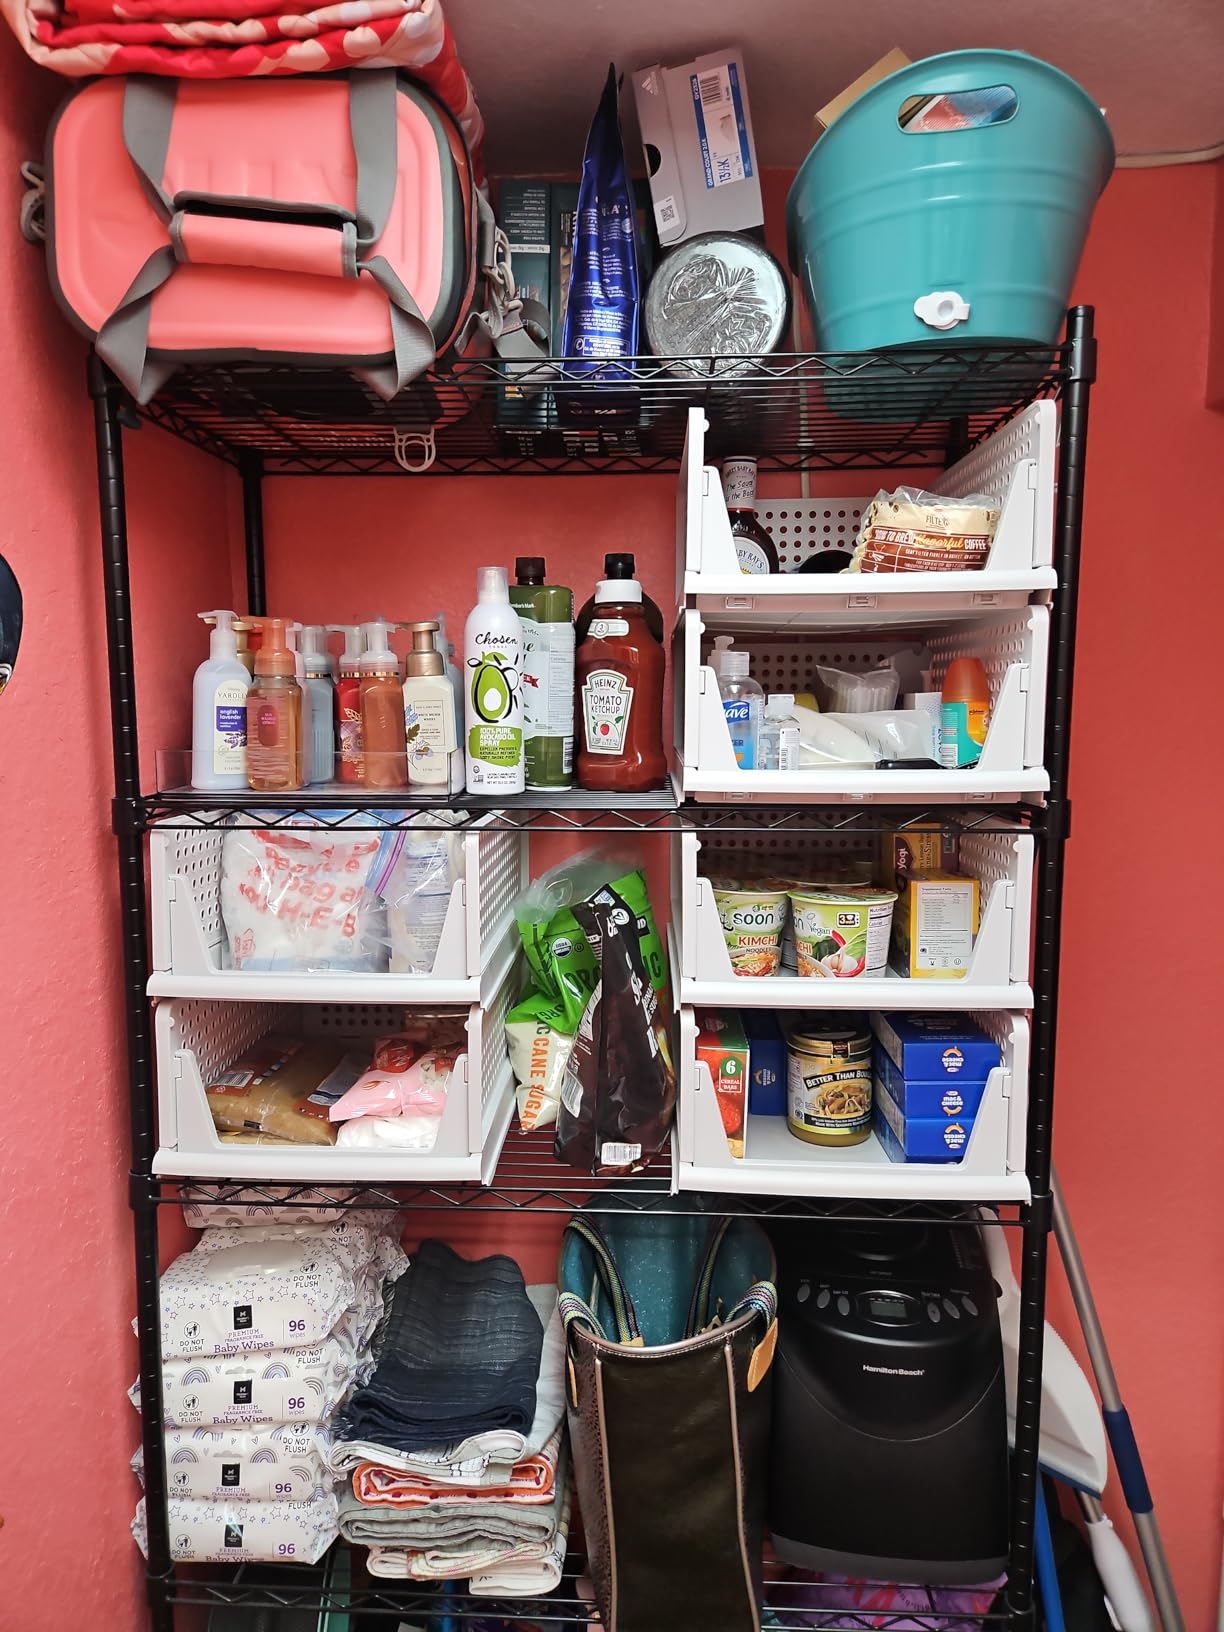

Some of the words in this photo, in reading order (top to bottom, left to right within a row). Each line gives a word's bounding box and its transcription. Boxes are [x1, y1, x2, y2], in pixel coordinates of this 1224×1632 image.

[704, 149, 712, 168] COURT
[707, 167, 715, 187] GRAND
[887, 530, 896, 542] TO
[895, 531, 915, 544] BREW
[964, 537, 987, 551] COFFEE
[747, 552, 764, 569] RAY'S
[475, 631, 518, 645] Chosen
[594, 678, 618, 690] HEINZ
[589, 694, 622, 706] TOMATO
[590, 705, 621, 714] KETCHUP
[839, 914, 846, 925] 3
[738, 936, 778, 946] KIMCHI
[530, 1036, 551, 1079] CANE
[725, 1059, 737, 1075] 6
[806, 1074, 834, 1088] BETTER
[835, 1071, 855, 1081] THAN
[295, 1280, 319, 1288] FLUSH
[288, 1319, 306, 1332] 96
[228, 1329, 260, 1338] PREMIUM
[289, 1331, 306, 1339] wipes
[182, 1345, 203, 1353] FLUSH
[213, 1343, 240, 1354] Baby
[241, 1340, 275, 1351] Wipes
[308, 1348, 323, 1356] NOT
[298, 1356, 321, 1364] FLUSH
[862, 1364, 898, 1375] Hamilton
[898, 1368, 923, 1376] Beach
[288, 1397, 305, 1409] 96
[213, 1416, 238, 1425] Baby
[241, 1415, 273, 1423] Wipes
[284, 1445, 307, 1453] FLUSH
[274, 1482, 292, 1494] 96
[288, 1501, 312, 1510] FLUSH
[278, 1543, 295, 1555] 96
